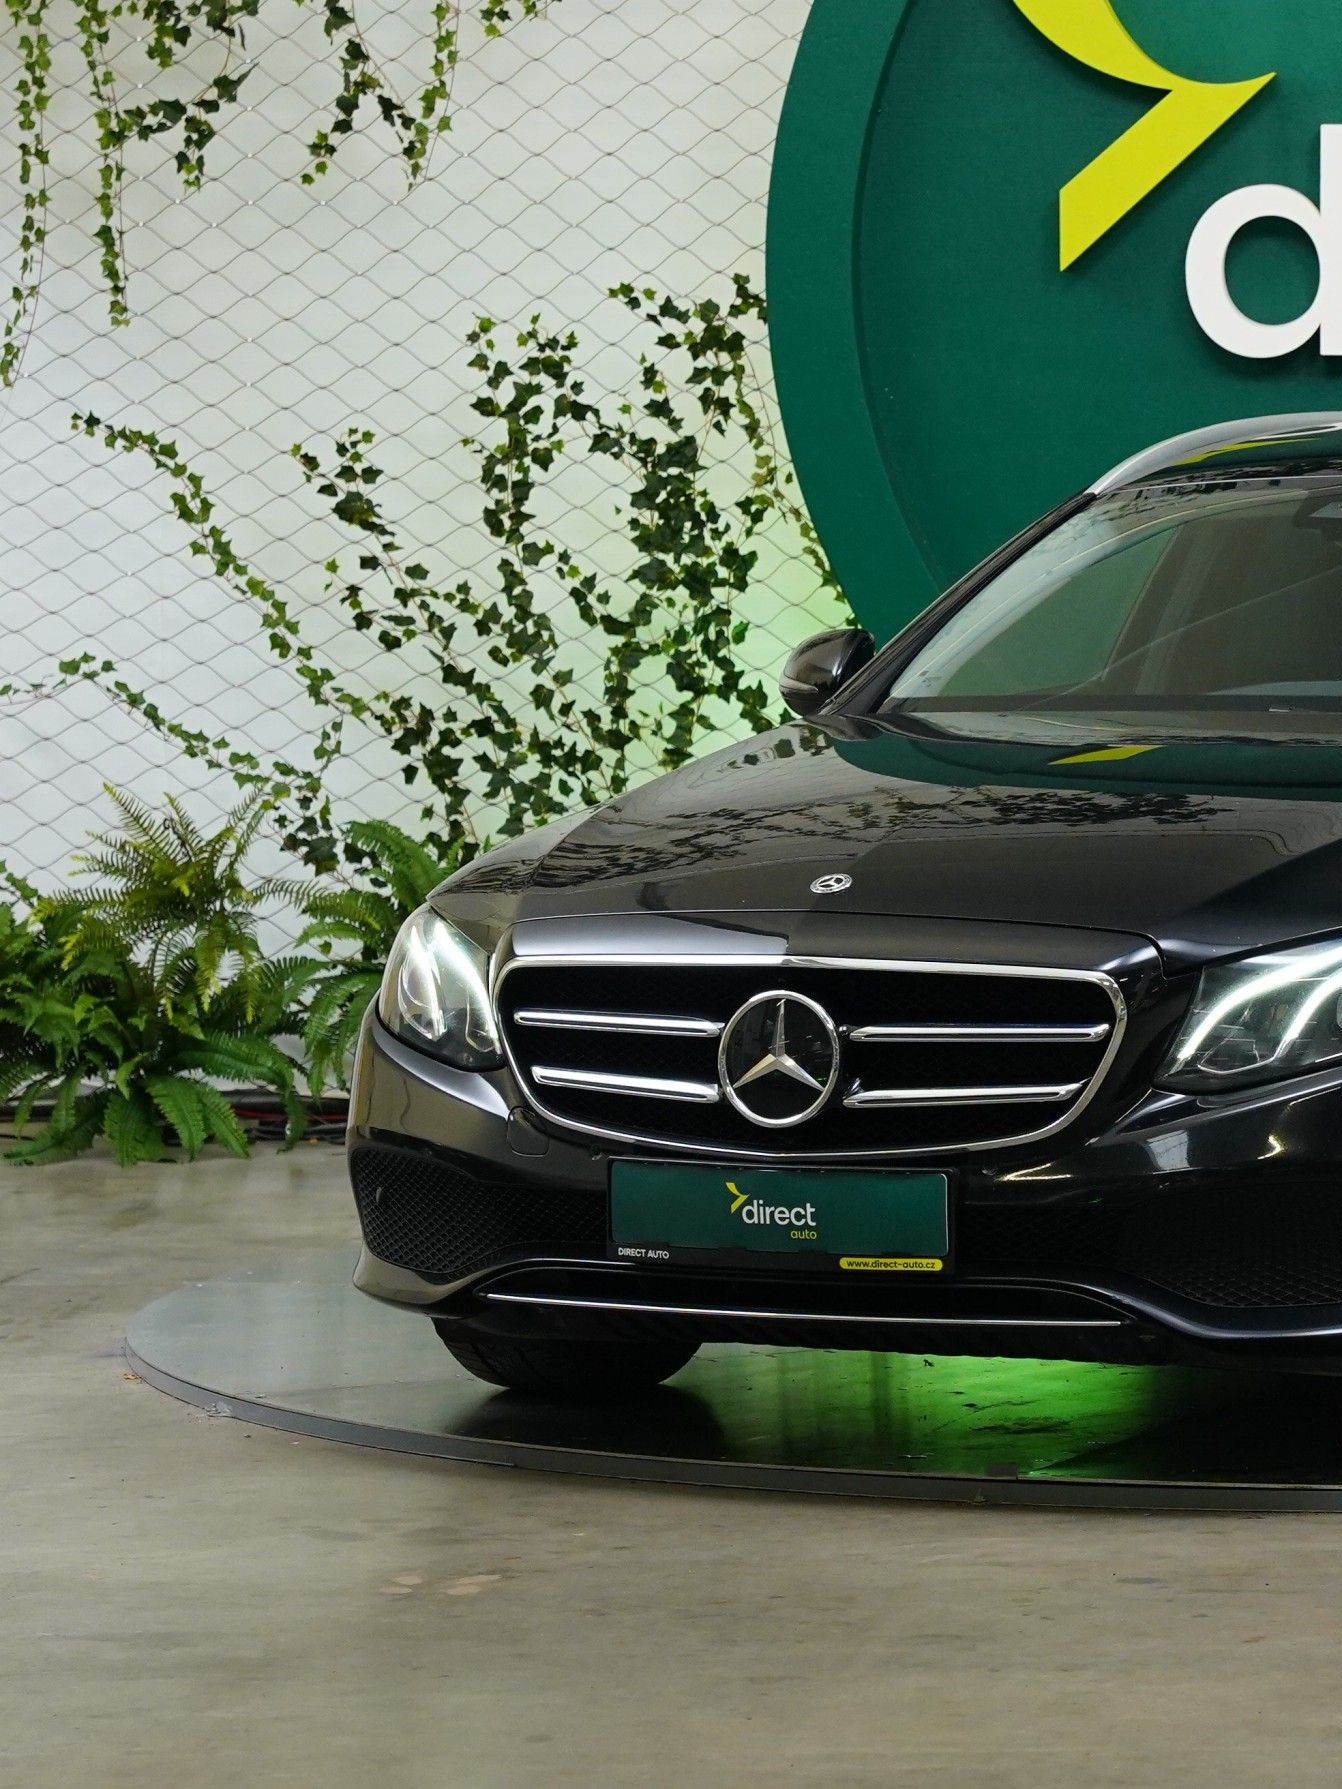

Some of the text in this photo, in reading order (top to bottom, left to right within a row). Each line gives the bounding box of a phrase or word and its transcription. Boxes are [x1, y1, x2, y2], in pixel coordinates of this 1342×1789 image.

[742, 1199, 817, 1227] direct
[790, 1229, 817, 1240] auto
[617, 1247, 670, 1259] DIRECT AUTO
[846, 1259, 936, 1269] www.direct-auto.cz
